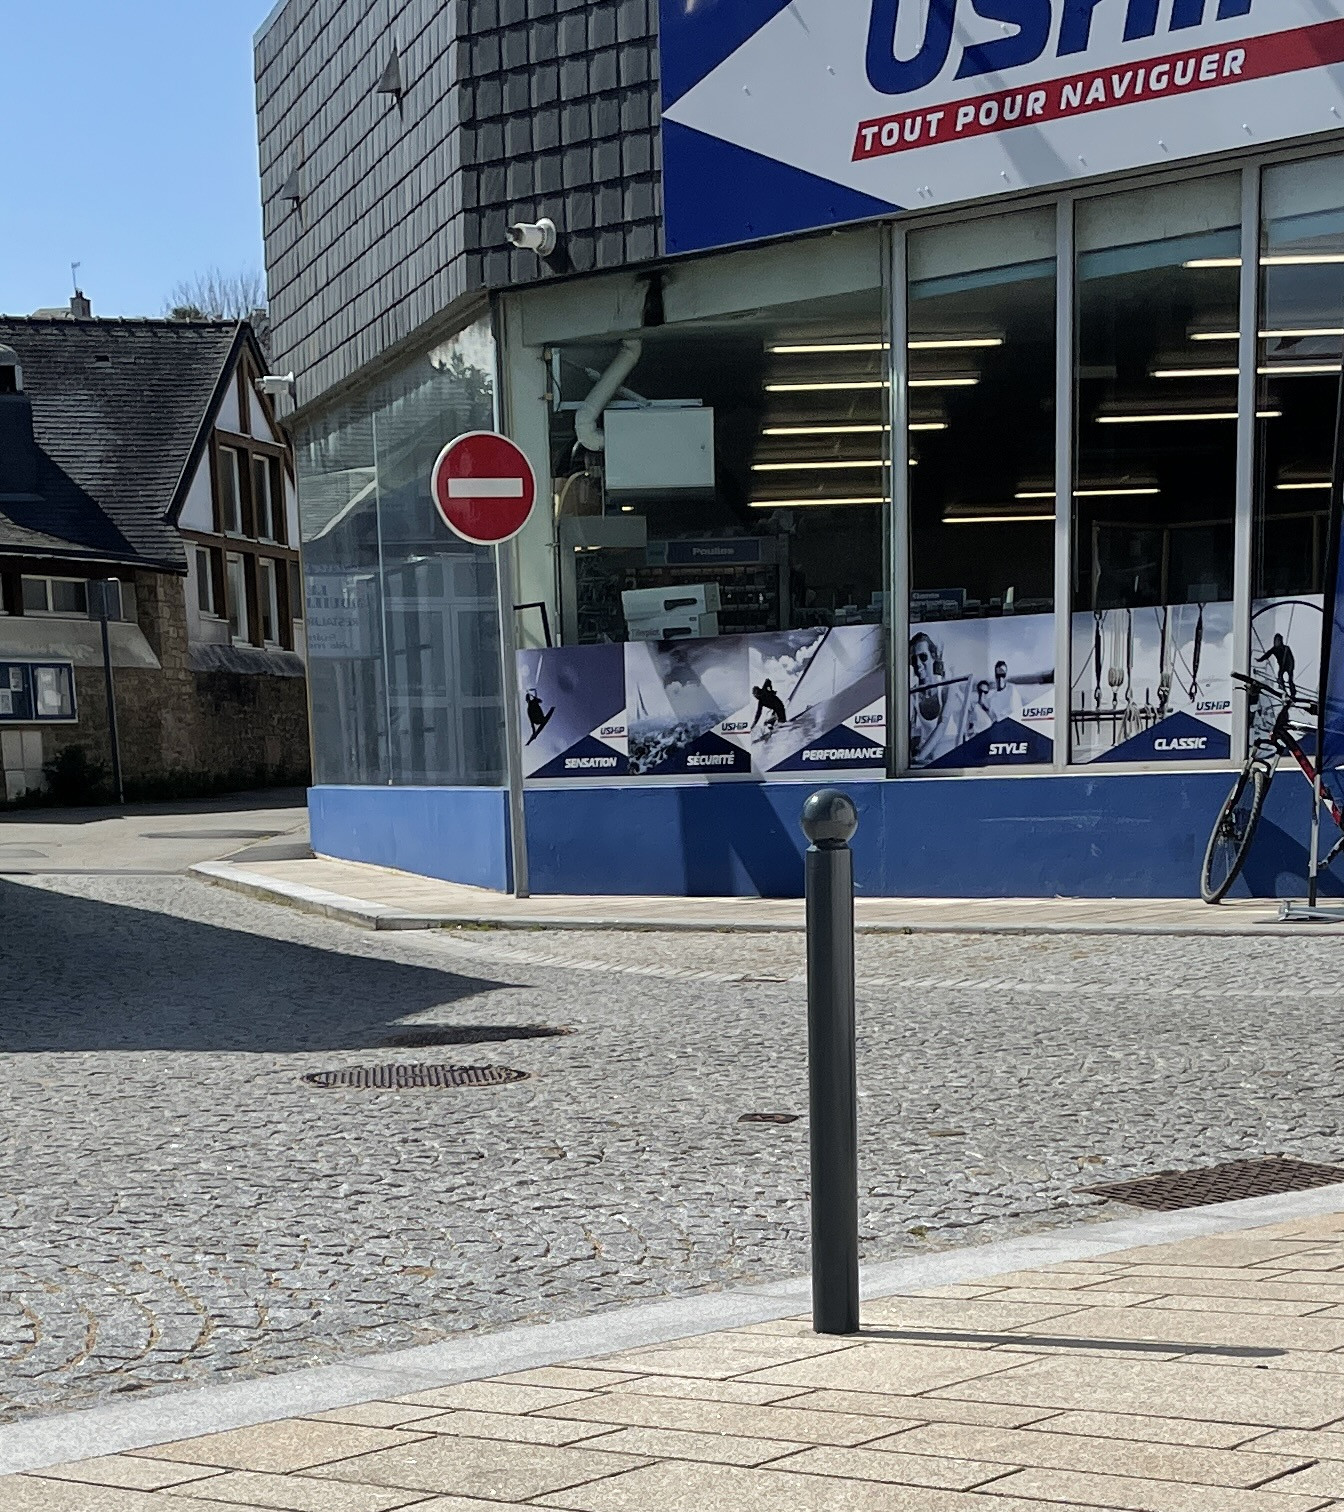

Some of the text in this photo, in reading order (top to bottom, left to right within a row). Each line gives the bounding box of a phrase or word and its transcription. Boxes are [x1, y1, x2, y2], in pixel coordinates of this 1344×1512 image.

[860, 48, 1248, 151] TOUT POUR NAVIGUER
[989, 742, 1028, 755] STYLE
[1154, 737, 1207, 750] CLASSIC
[686, 751, 735, 766] SÉCURITÉ
[802, 747, 885, 762] PERFORMANCE
[564, 757, 617, 769] SENSATION
